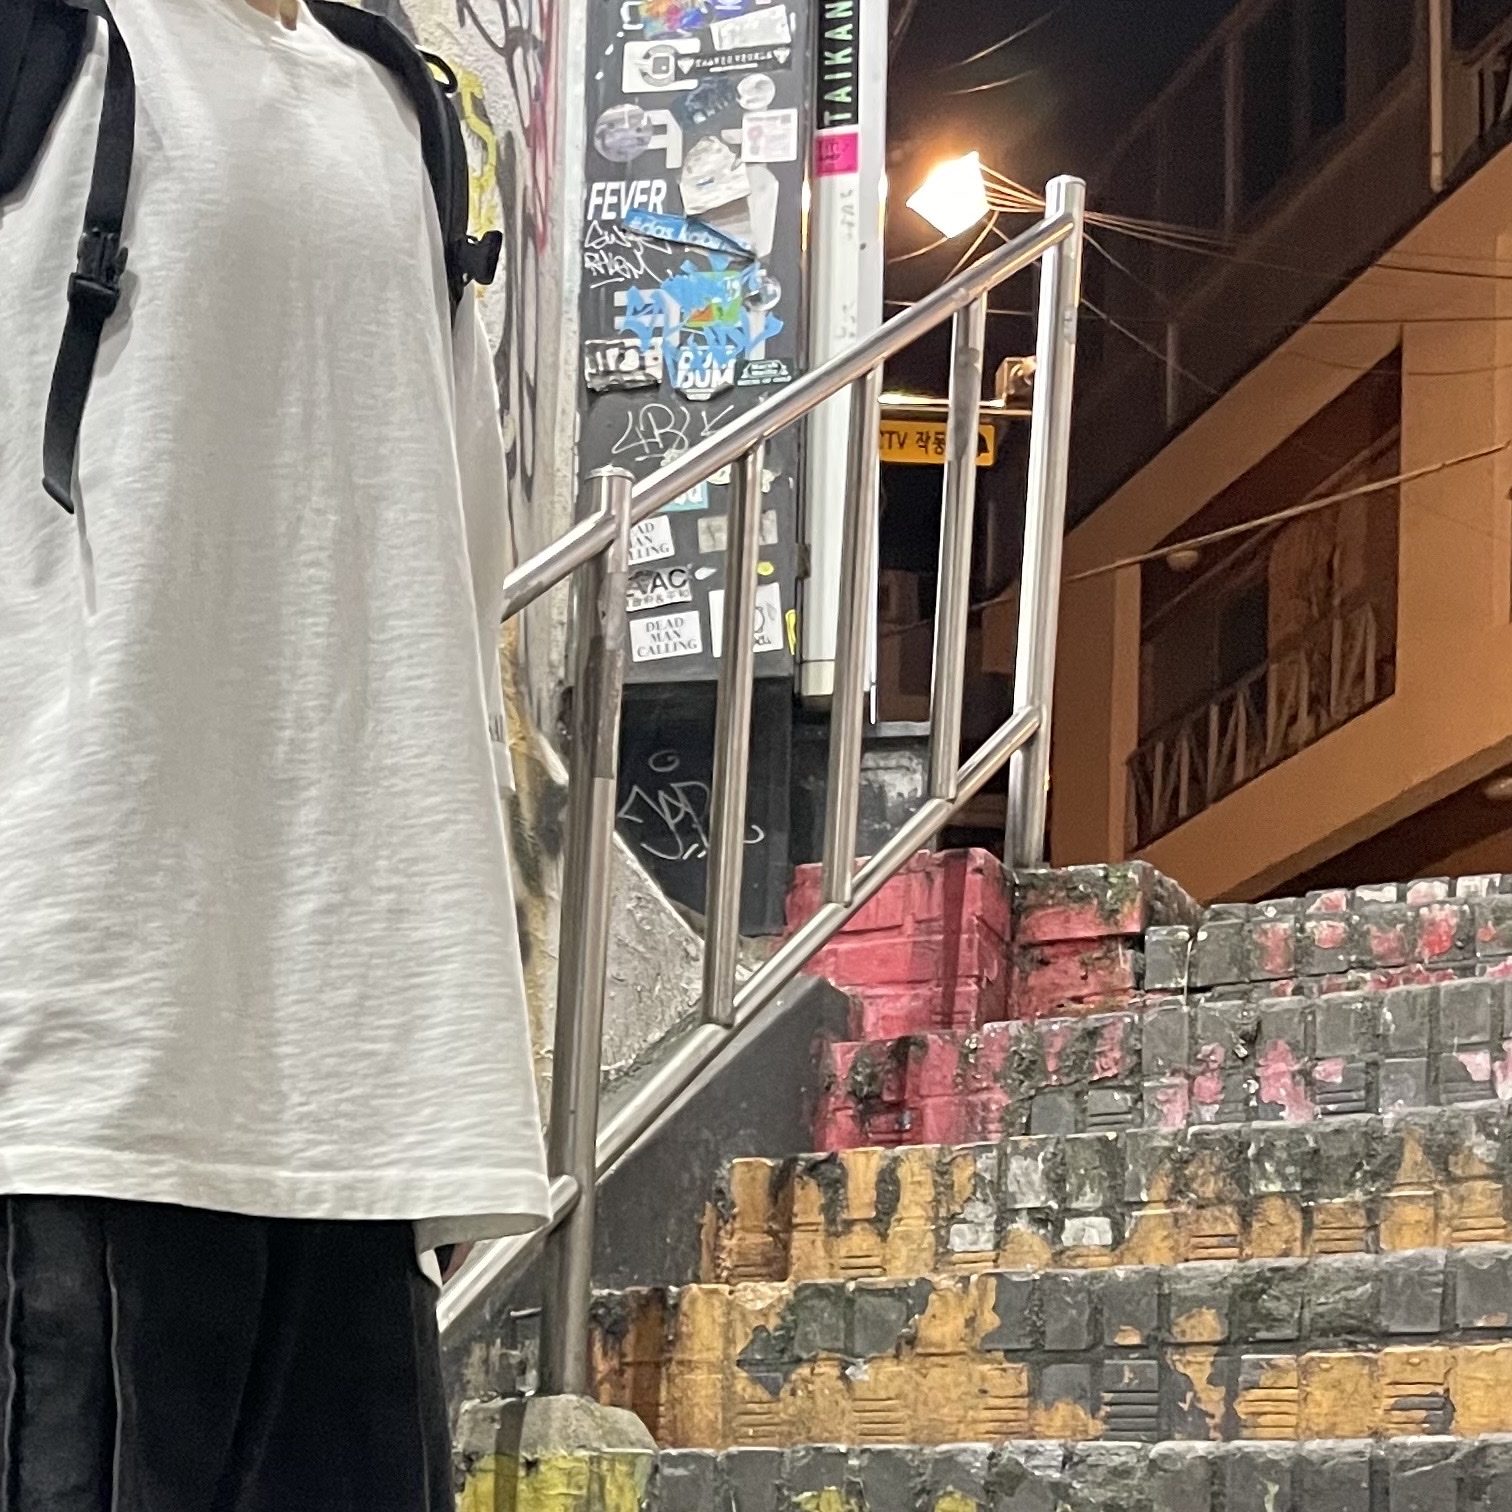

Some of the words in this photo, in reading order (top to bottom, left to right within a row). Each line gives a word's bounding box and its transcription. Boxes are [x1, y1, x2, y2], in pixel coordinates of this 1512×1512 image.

[824, 1, 854, 126] TAIKAN
[587, 179, 667, 220] FEVER
[880, 431, 908, 450] TV
[645, 617, 685, 633] DEAD
[650, 629, 682, 643] MAN
[636, 638, 698, 658] CALLING
